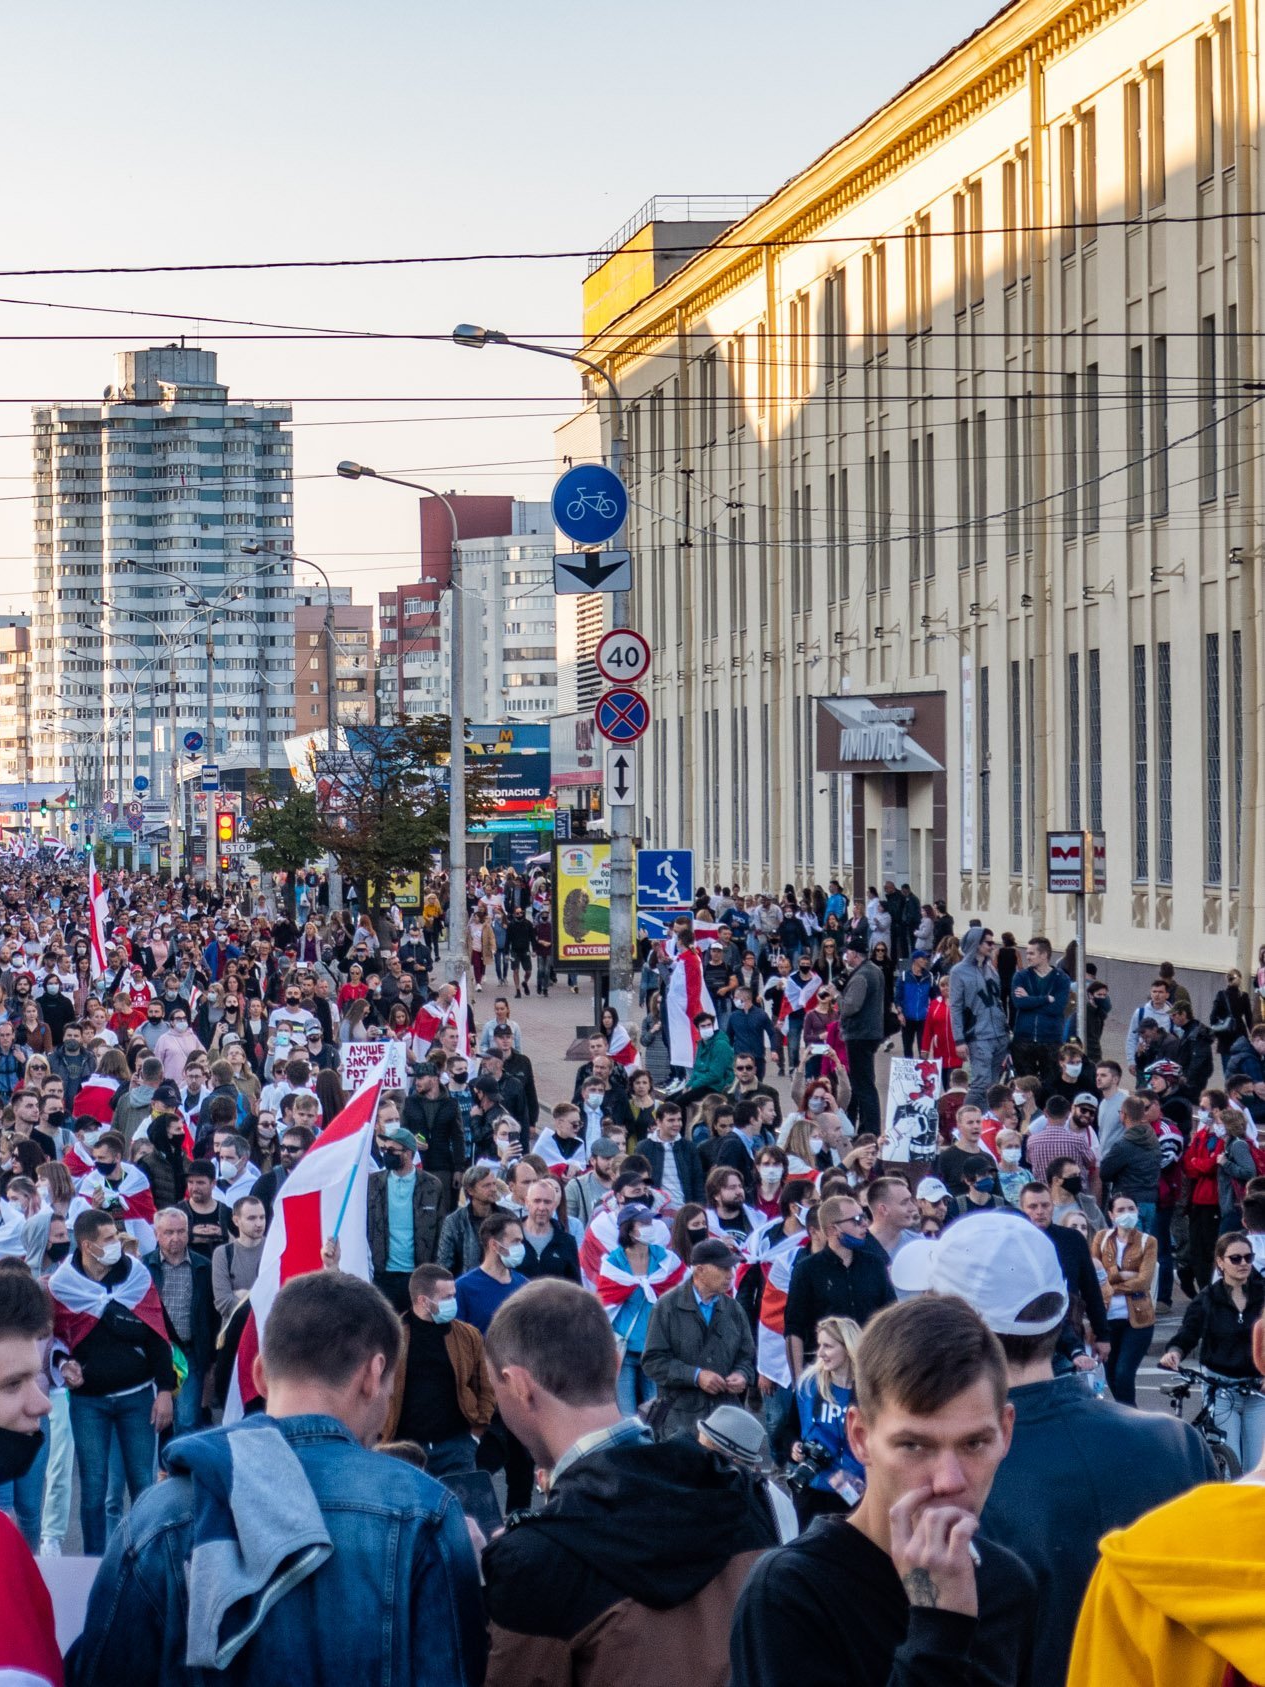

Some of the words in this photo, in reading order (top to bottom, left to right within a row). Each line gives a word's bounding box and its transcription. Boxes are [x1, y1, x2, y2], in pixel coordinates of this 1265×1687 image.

[607, 646, 640, 668] 40
[839, 727, 908, 761] ИМПУЛЬС
[225, 843, 252, 852] STOP
[1052, 879, 1079, 888] переход
[349, 1044, 386, 1057] ЛУЧШЕ
